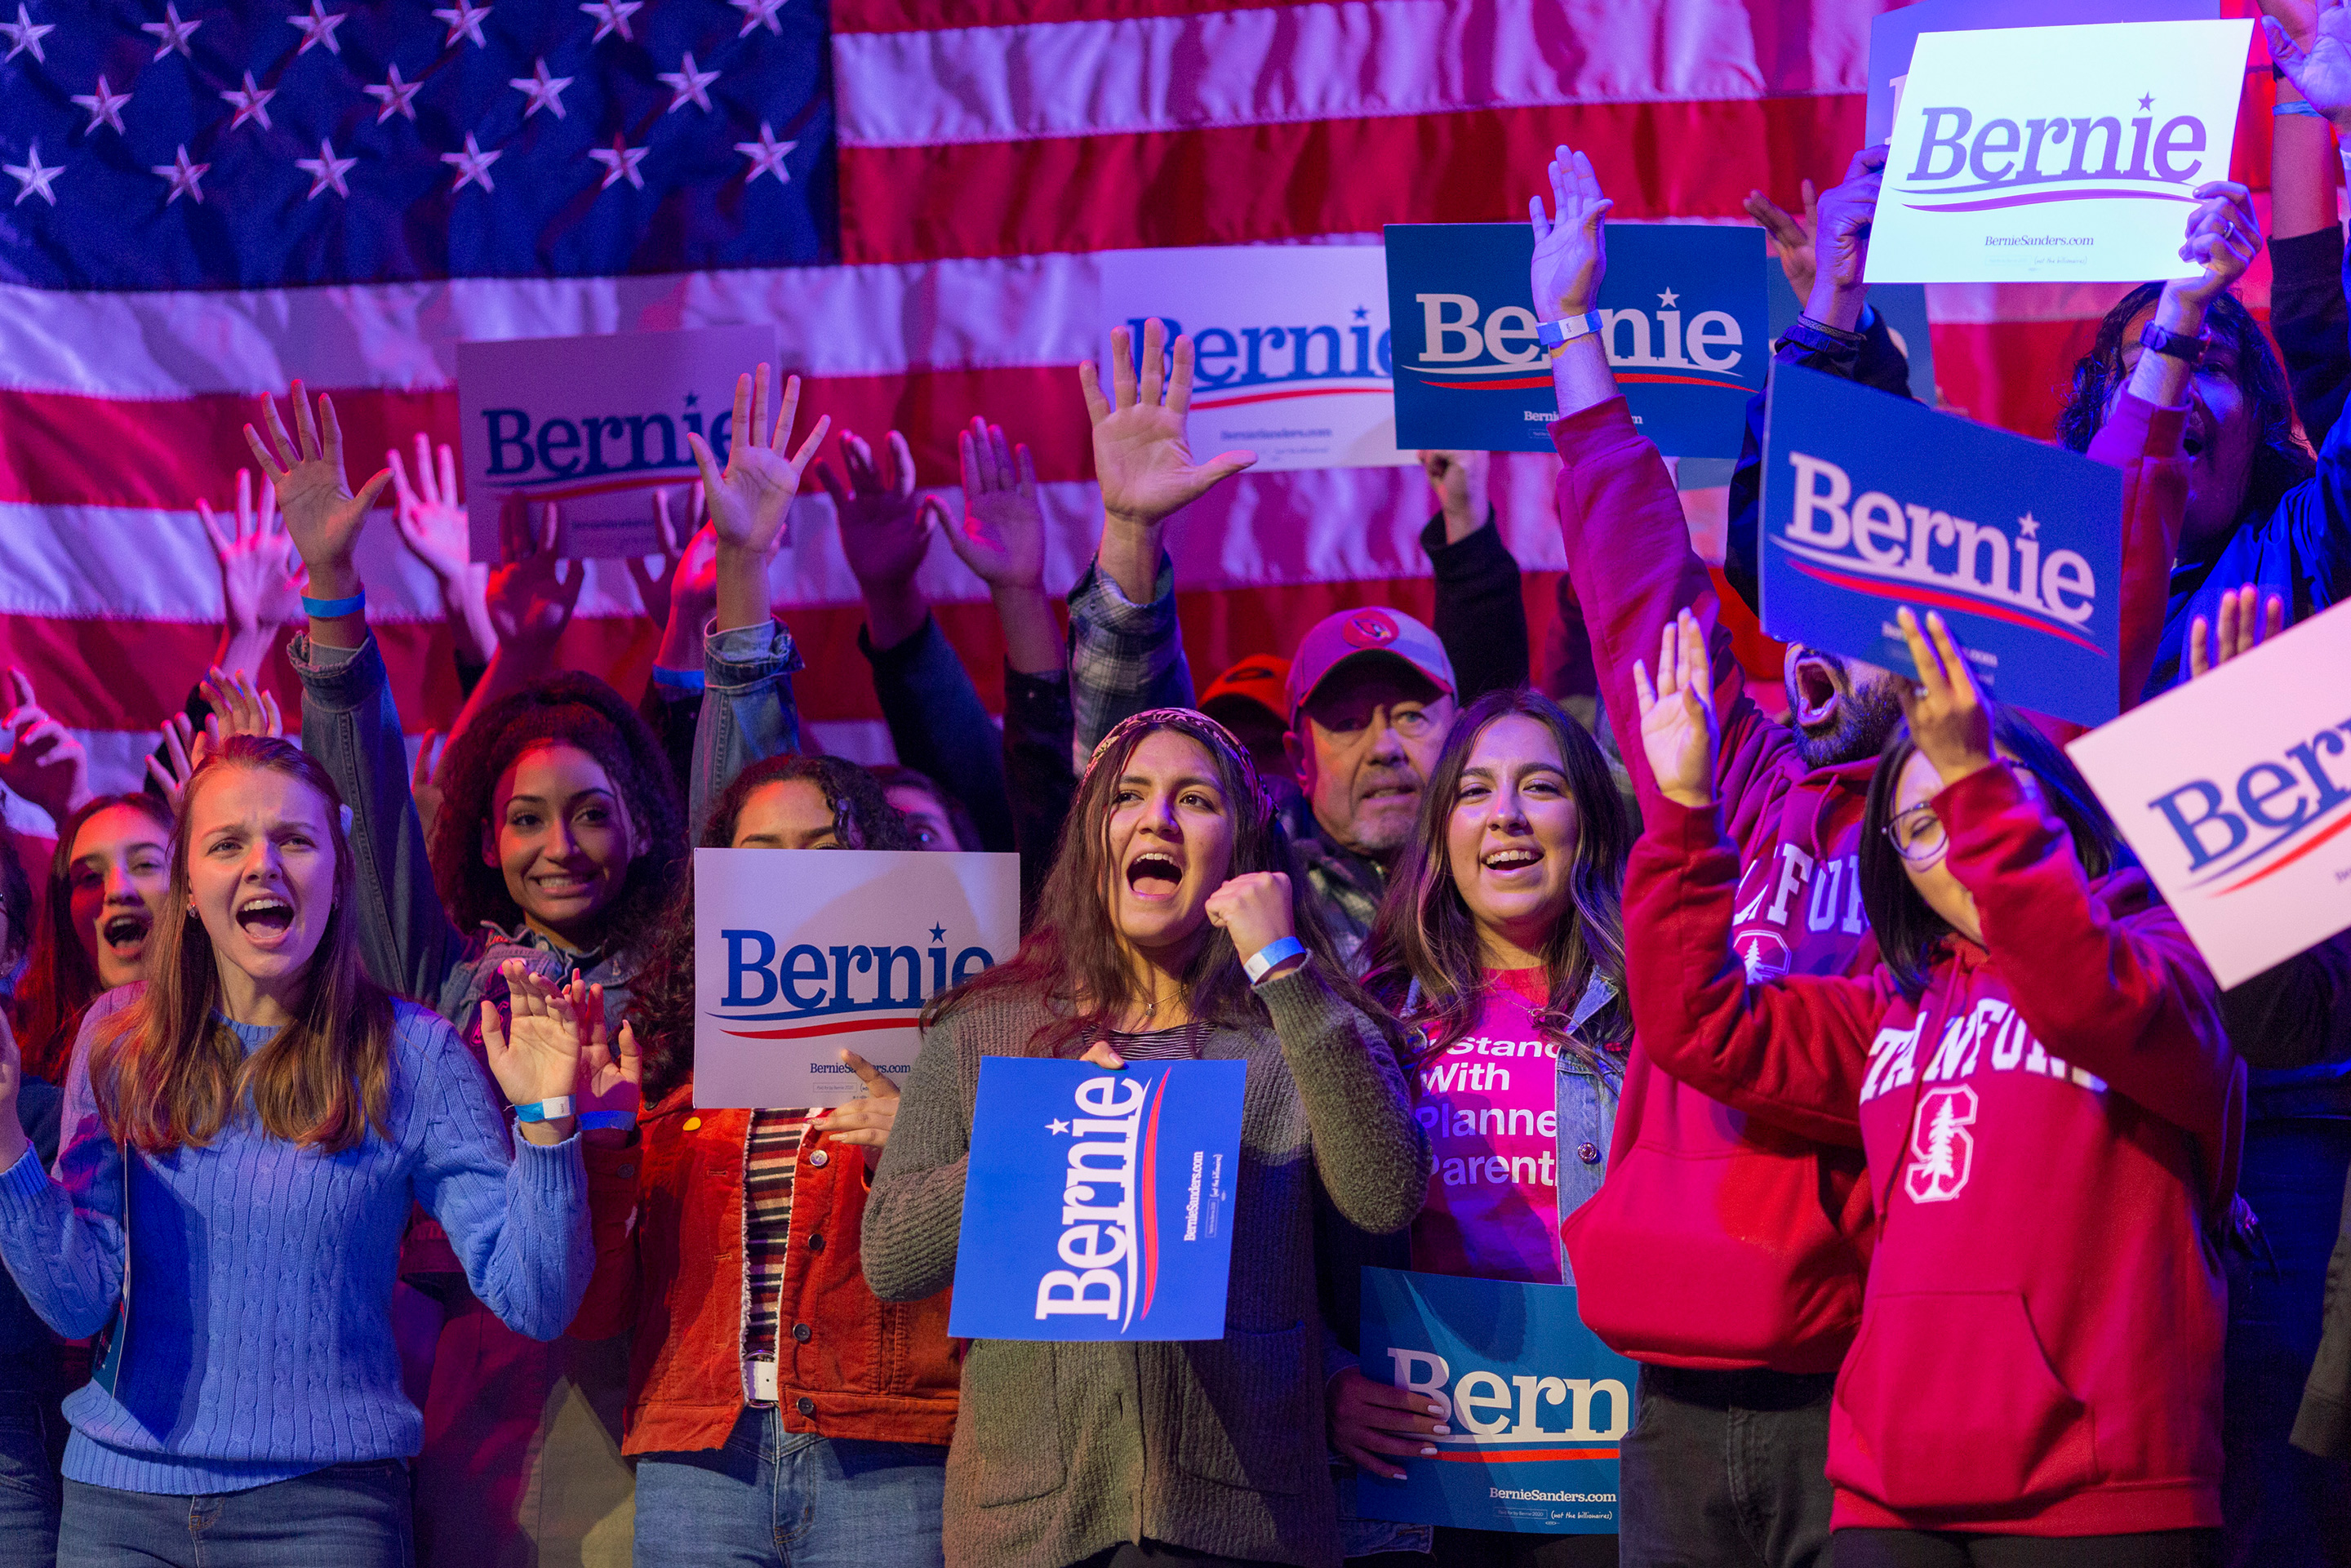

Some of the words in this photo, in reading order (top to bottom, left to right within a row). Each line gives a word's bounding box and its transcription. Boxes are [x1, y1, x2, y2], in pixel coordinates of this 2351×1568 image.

[1906, 91, 2207, 181] Bernie
[1984, 235, 2094, 246] BernieSanders.com
[1415, 287, 1744, 372] Benie
[1784, 451, 2096, 625] Bernie
[2148, 717, 2351, 873] Ber
[1420, 1062, 1510, 1096] With
[1035, 1044, 1144, 1321] Bernie
[1184, 1151, 1204, 1242] BernieSanders.com
[1431, 1151, 1558, 1186] arent
[1387, 1348, 1629, 1437] Bern
[1489, 1487, 1617, 1502] BernieSanders.com
[1550, 1510, 1564, 1520] (not
[1565, 1511, 1576, 1519] the
[1577, 1511, 1613, 1520] billionaires)
